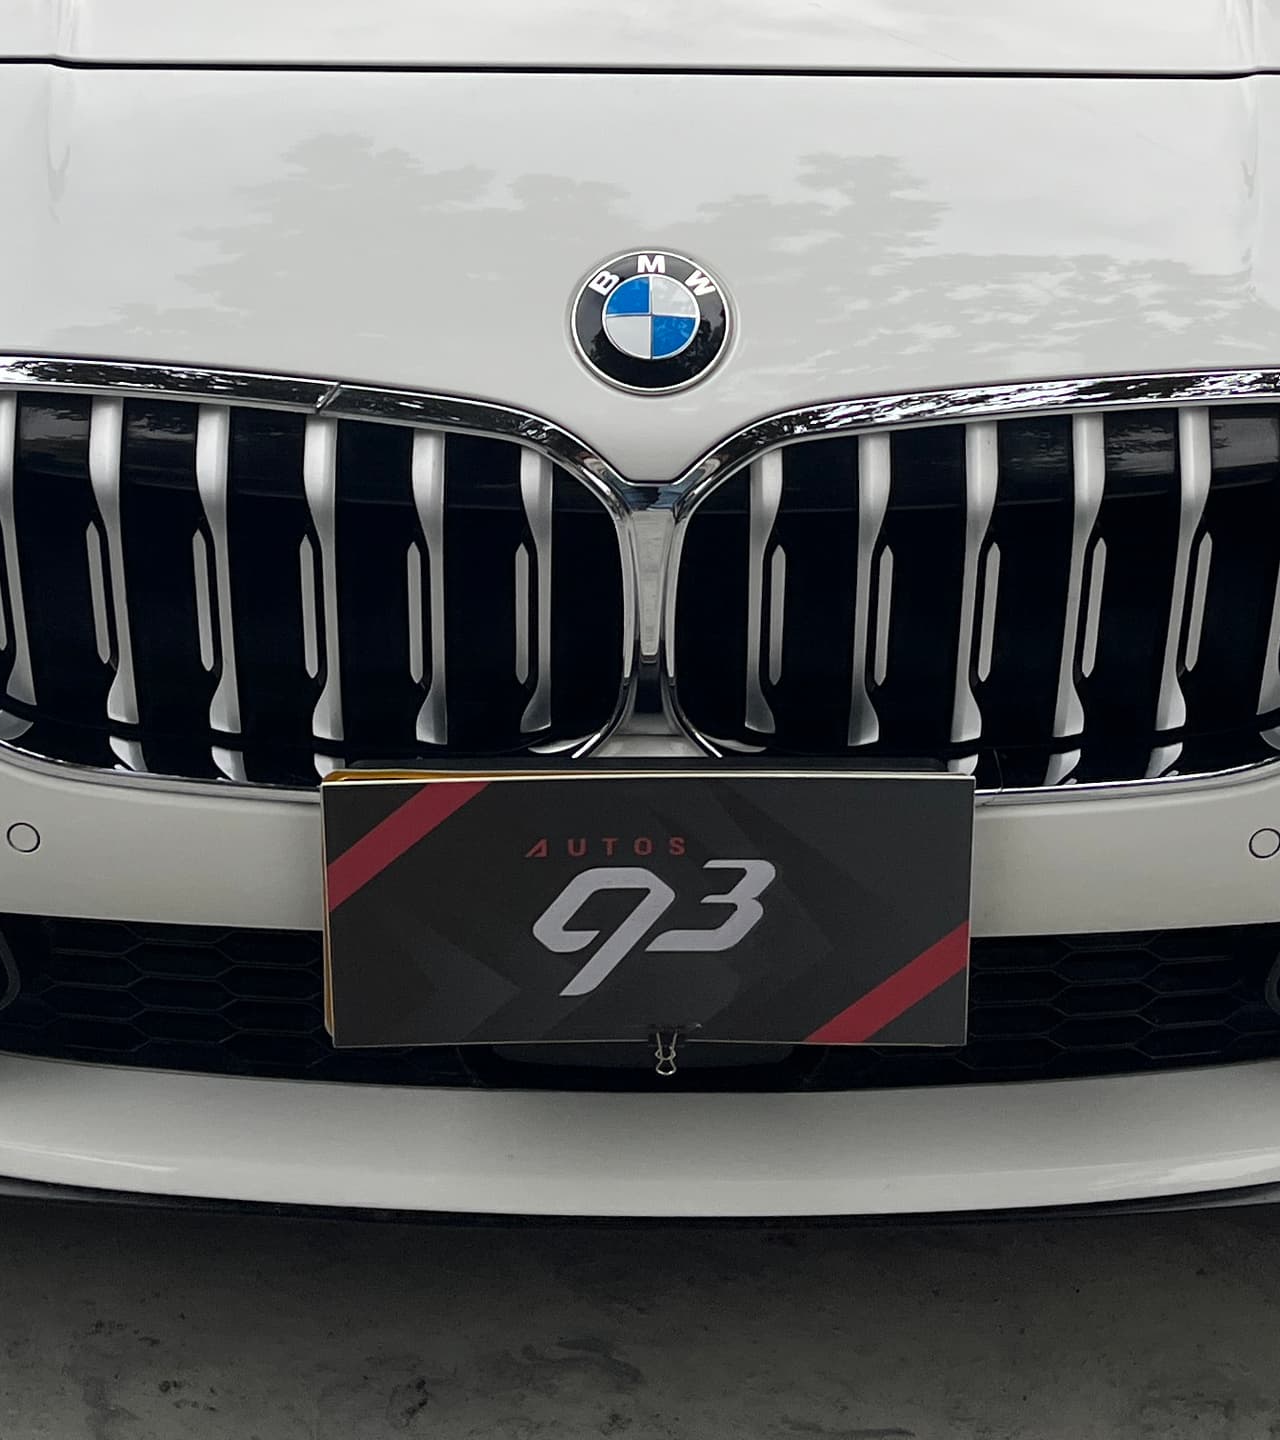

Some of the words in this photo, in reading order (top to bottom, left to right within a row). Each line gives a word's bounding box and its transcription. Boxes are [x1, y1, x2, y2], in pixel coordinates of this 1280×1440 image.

[588, 254, 716, 296] BMW
[525, 837, 686, 857] AUTOS
[532, 859, 776, 996] 93
